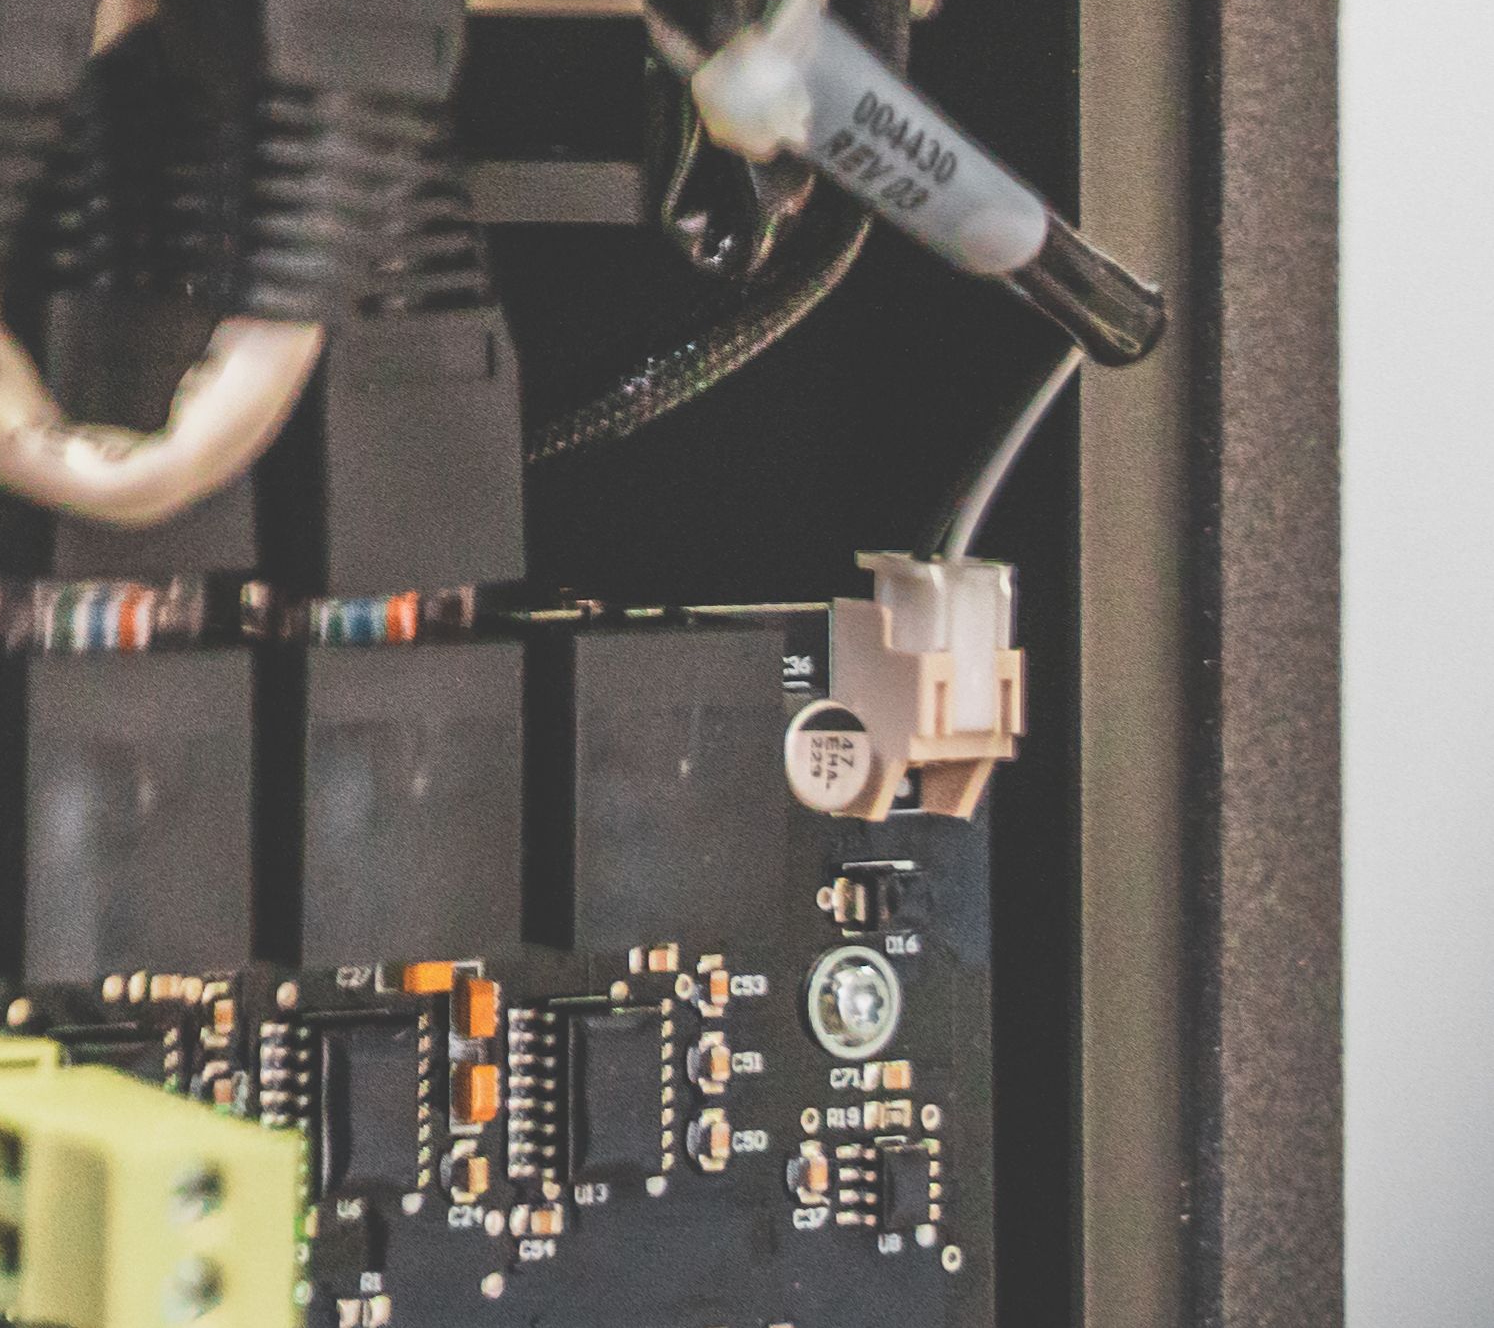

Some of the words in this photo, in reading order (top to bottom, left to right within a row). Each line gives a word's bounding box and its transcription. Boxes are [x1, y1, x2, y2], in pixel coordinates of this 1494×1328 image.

[853, 90, 958, 184] 004430
[827, 129, 892, 185] REV
[730, 975, 768, 996] C53
[732, 1051, 764, 1074] C51
[732, 1129, 768, 1153] C50
